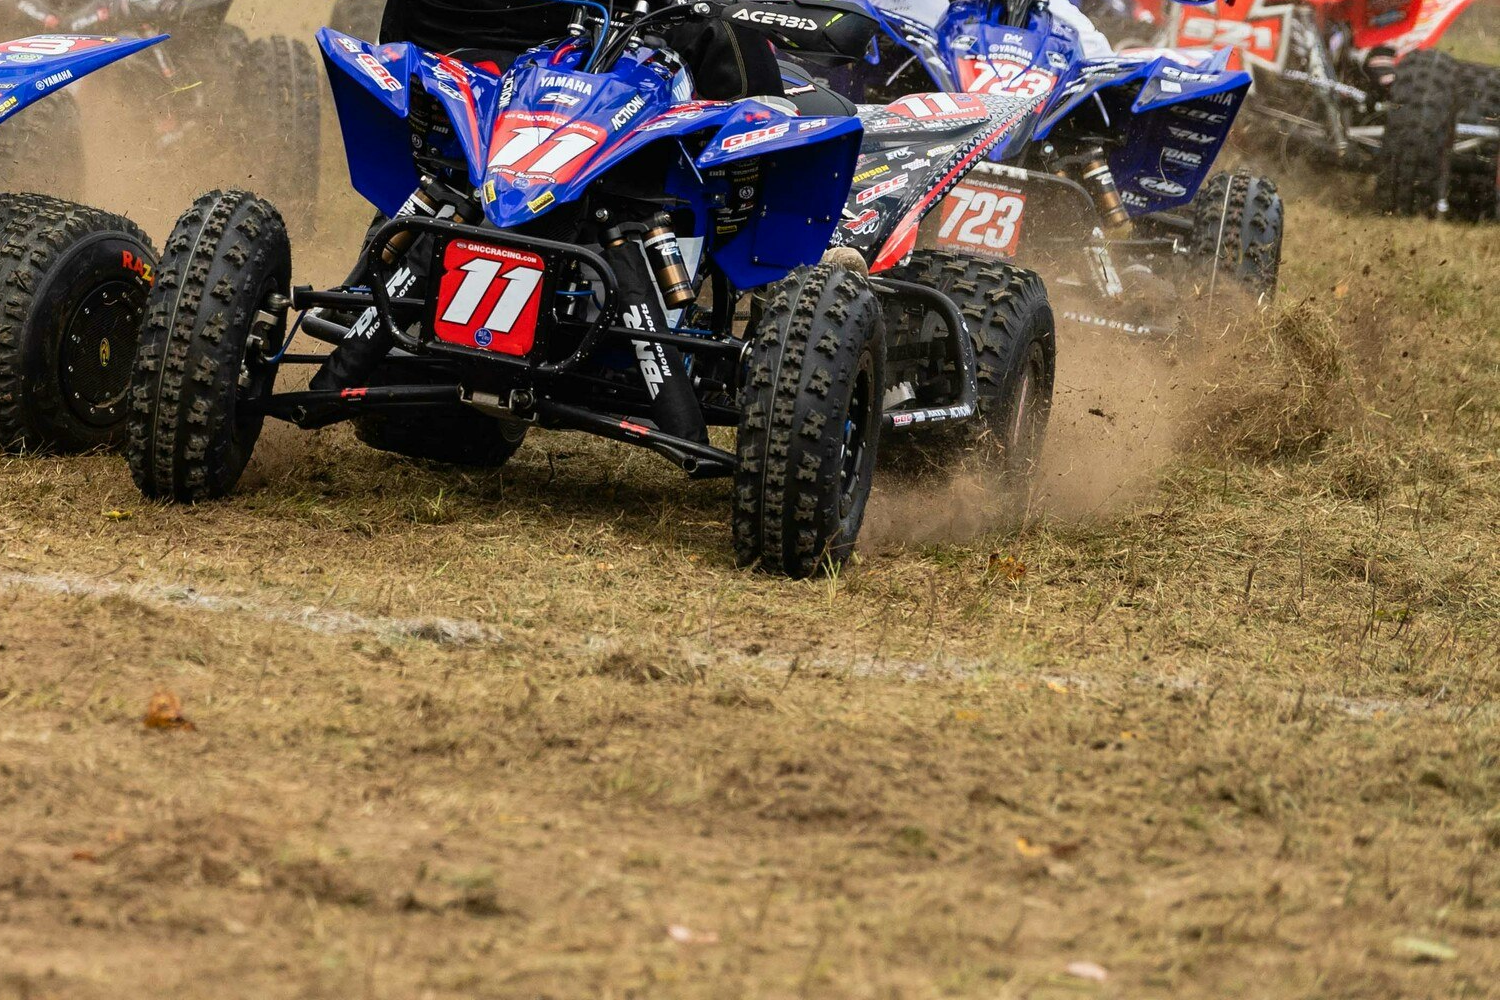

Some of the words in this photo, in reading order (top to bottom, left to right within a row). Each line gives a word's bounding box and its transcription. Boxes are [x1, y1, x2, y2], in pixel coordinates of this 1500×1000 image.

[731, 8, 819, 31] ACERBIS
[43, 69, 73, 87] YAMAHA
[539, 76, 593, 96] YAMAHA
[967, 61, 1050, 99] 723
[542, 92, 581, 107] SSI
[898, 92, 965, 118] 11
[610, 94, 646, 131] ACTION!
[723, 122, 790, 150] GBC
[799, 119, 827, 131] SSI
[1178, 127, 1217, 144] FLY
[487, 125, 599, 174] 11
[852, 164, 890, 183] HINSON
[856, 173, 909, 203] GBC
[938, 187, 1025, 249] 723
[467, 244, 538, 264] GNCCRACING.COM
[440, 257, 544, 334] 11
